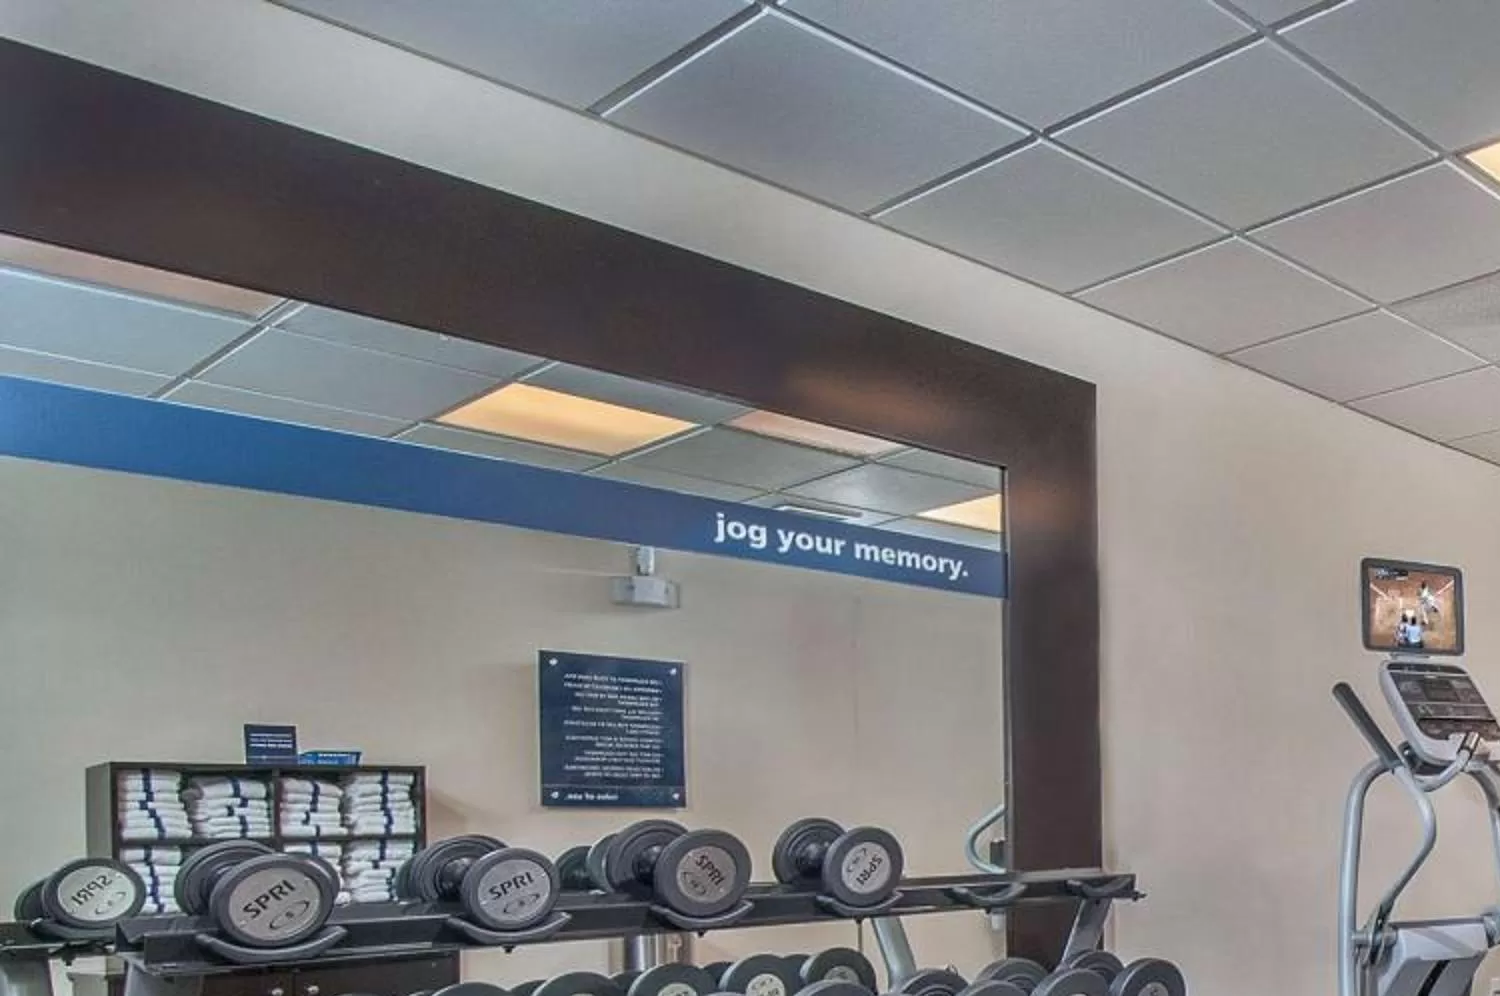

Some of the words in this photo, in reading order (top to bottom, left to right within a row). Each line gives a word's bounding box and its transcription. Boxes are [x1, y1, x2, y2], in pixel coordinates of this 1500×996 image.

[714, 513, 767, 548] jog
[777, 528, 846, 556] your
[854, 541, 969, 580] memory.
[489, 871, 535, 901] SPRI
[695, 854, 726, 887] SPRI
[855, 854, 883, 886] SPRI
[243, 880, 295, 919] SPRI
